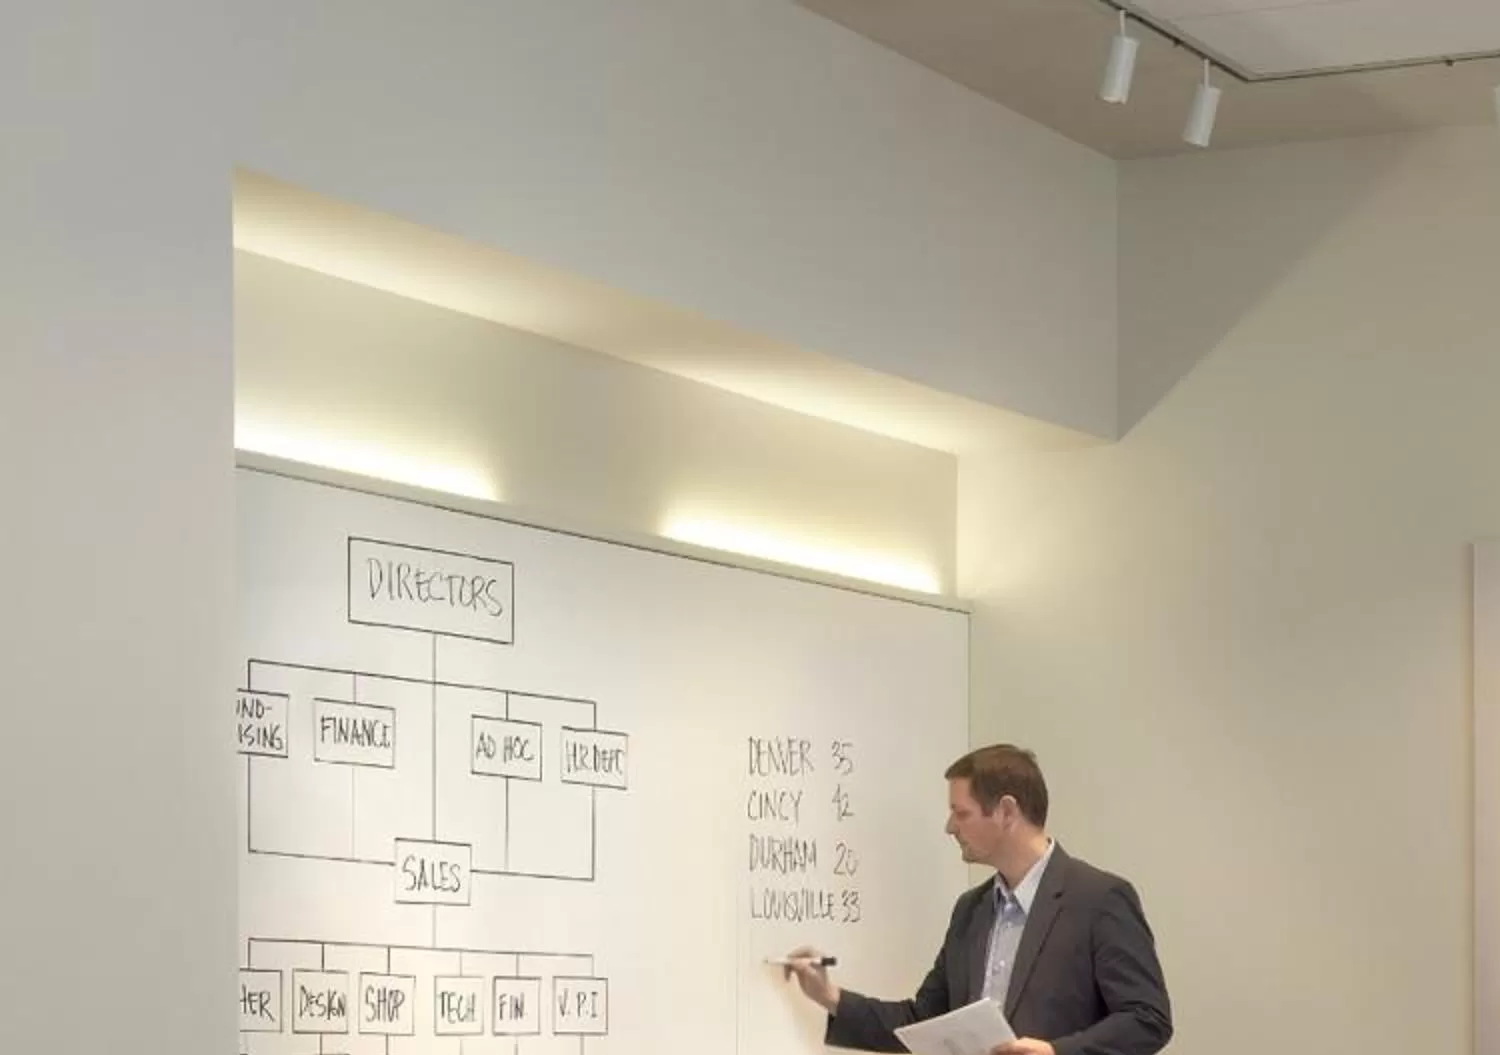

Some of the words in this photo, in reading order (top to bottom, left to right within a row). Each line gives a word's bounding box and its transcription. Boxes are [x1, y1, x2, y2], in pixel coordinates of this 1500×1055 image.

[367, 557, 503, 618] DIRECTORS
[319, 716, 392, 749] FINANCE
[475, 731, 497, 760] AD
[502, 733, 534, 763] HOC
[747, 735, 816, 777] DENVER
[747, 789, 803, 824] CINCY
[749, 833, 817, 875] DURHAM
[402, 854, 461, 893] SALES
[841, 889, 862, 923] 33
[299, 984, 347, 1020] DESIGN
[364, 985, 406, 1023] SHOP
[438, 990, 476, 1024] TECH
